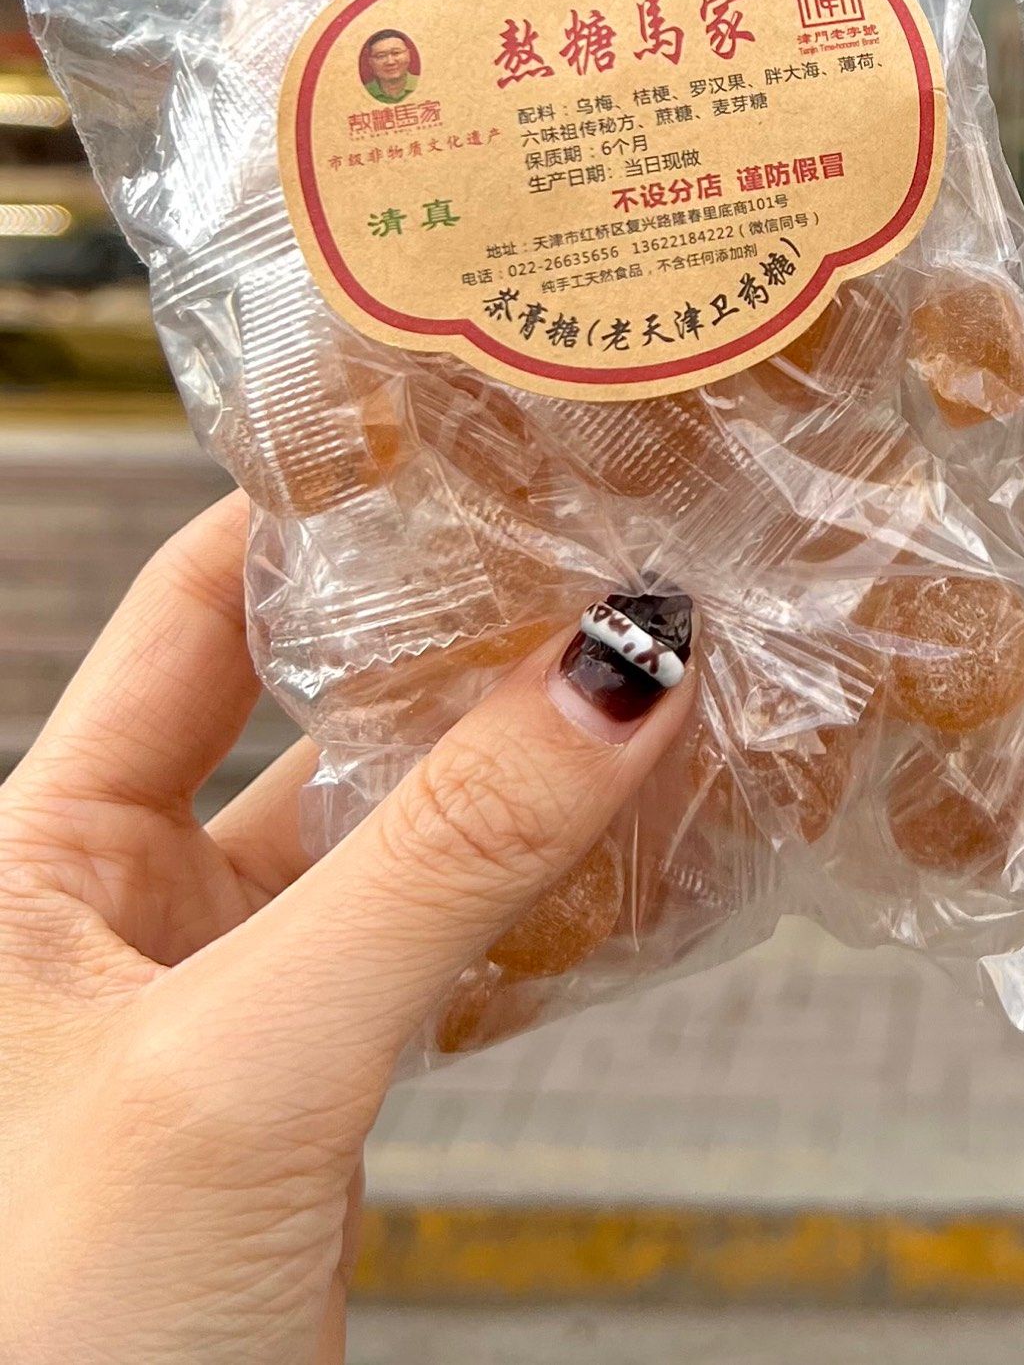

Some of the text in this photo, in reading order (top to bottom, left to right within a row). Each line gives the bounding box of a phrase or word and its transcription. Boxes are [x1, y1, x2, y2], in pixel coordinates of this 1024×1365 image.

[328, 127, 501, 170] 市级非物质文化遗产
[612, 152, 845, 214] 不设分店 谨防假冒
[368, 199, 461, 237] 清真
